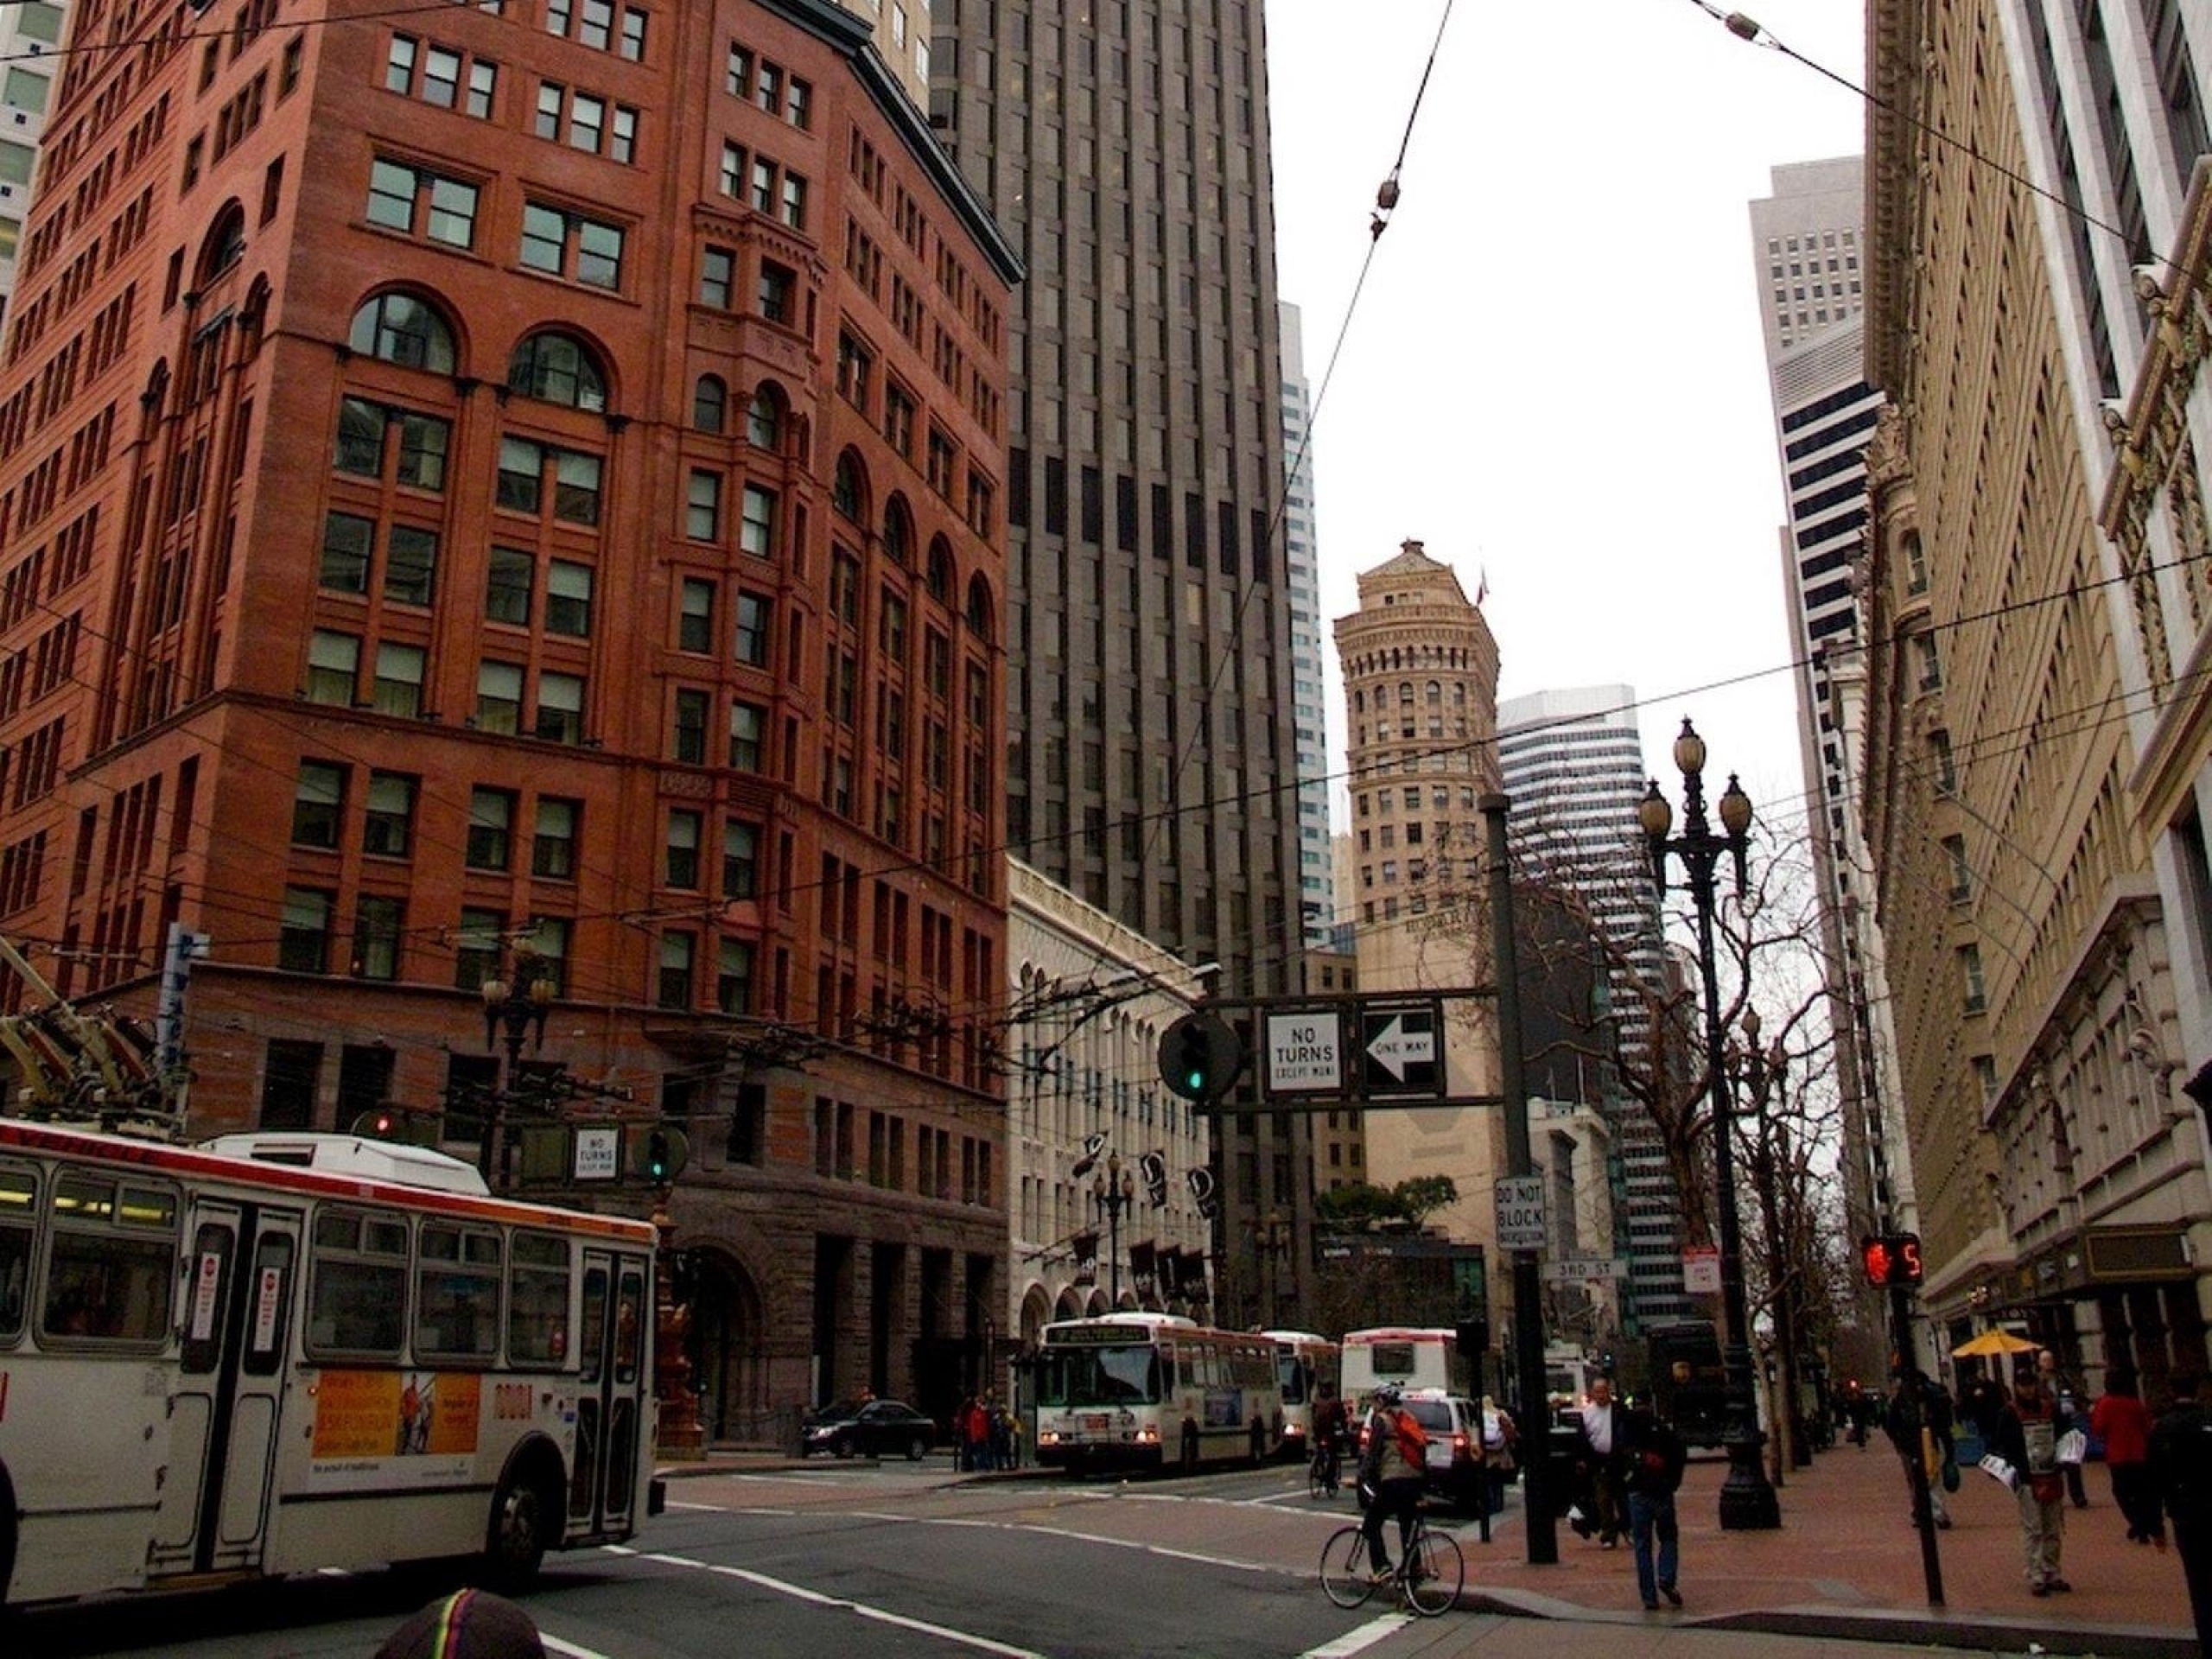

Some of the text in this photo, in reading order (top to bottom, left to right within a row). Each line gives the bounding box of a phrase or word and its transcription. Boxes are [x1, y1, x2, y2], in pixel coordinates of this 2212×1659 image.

[1292, 1027, 1316, 1044] NO
[1276, 1046, 1333, 1064] TURNS
[1375, 1041, 1430, 1055] ONE WAY
[1275, 1065, 1335, 1079] EXCEPT MUNI
[590, 1137, 605, 1147] NO
[580, 1150, 612, 1161] TURNS
[1497, 1185, 1541, 1203] DO NOT
[1497, 1208, 1542, 1228] BLOCK
[1904, 1243, 1920, 1276] 5
[1560, 1262, 1611, 1275] 3RD ST
